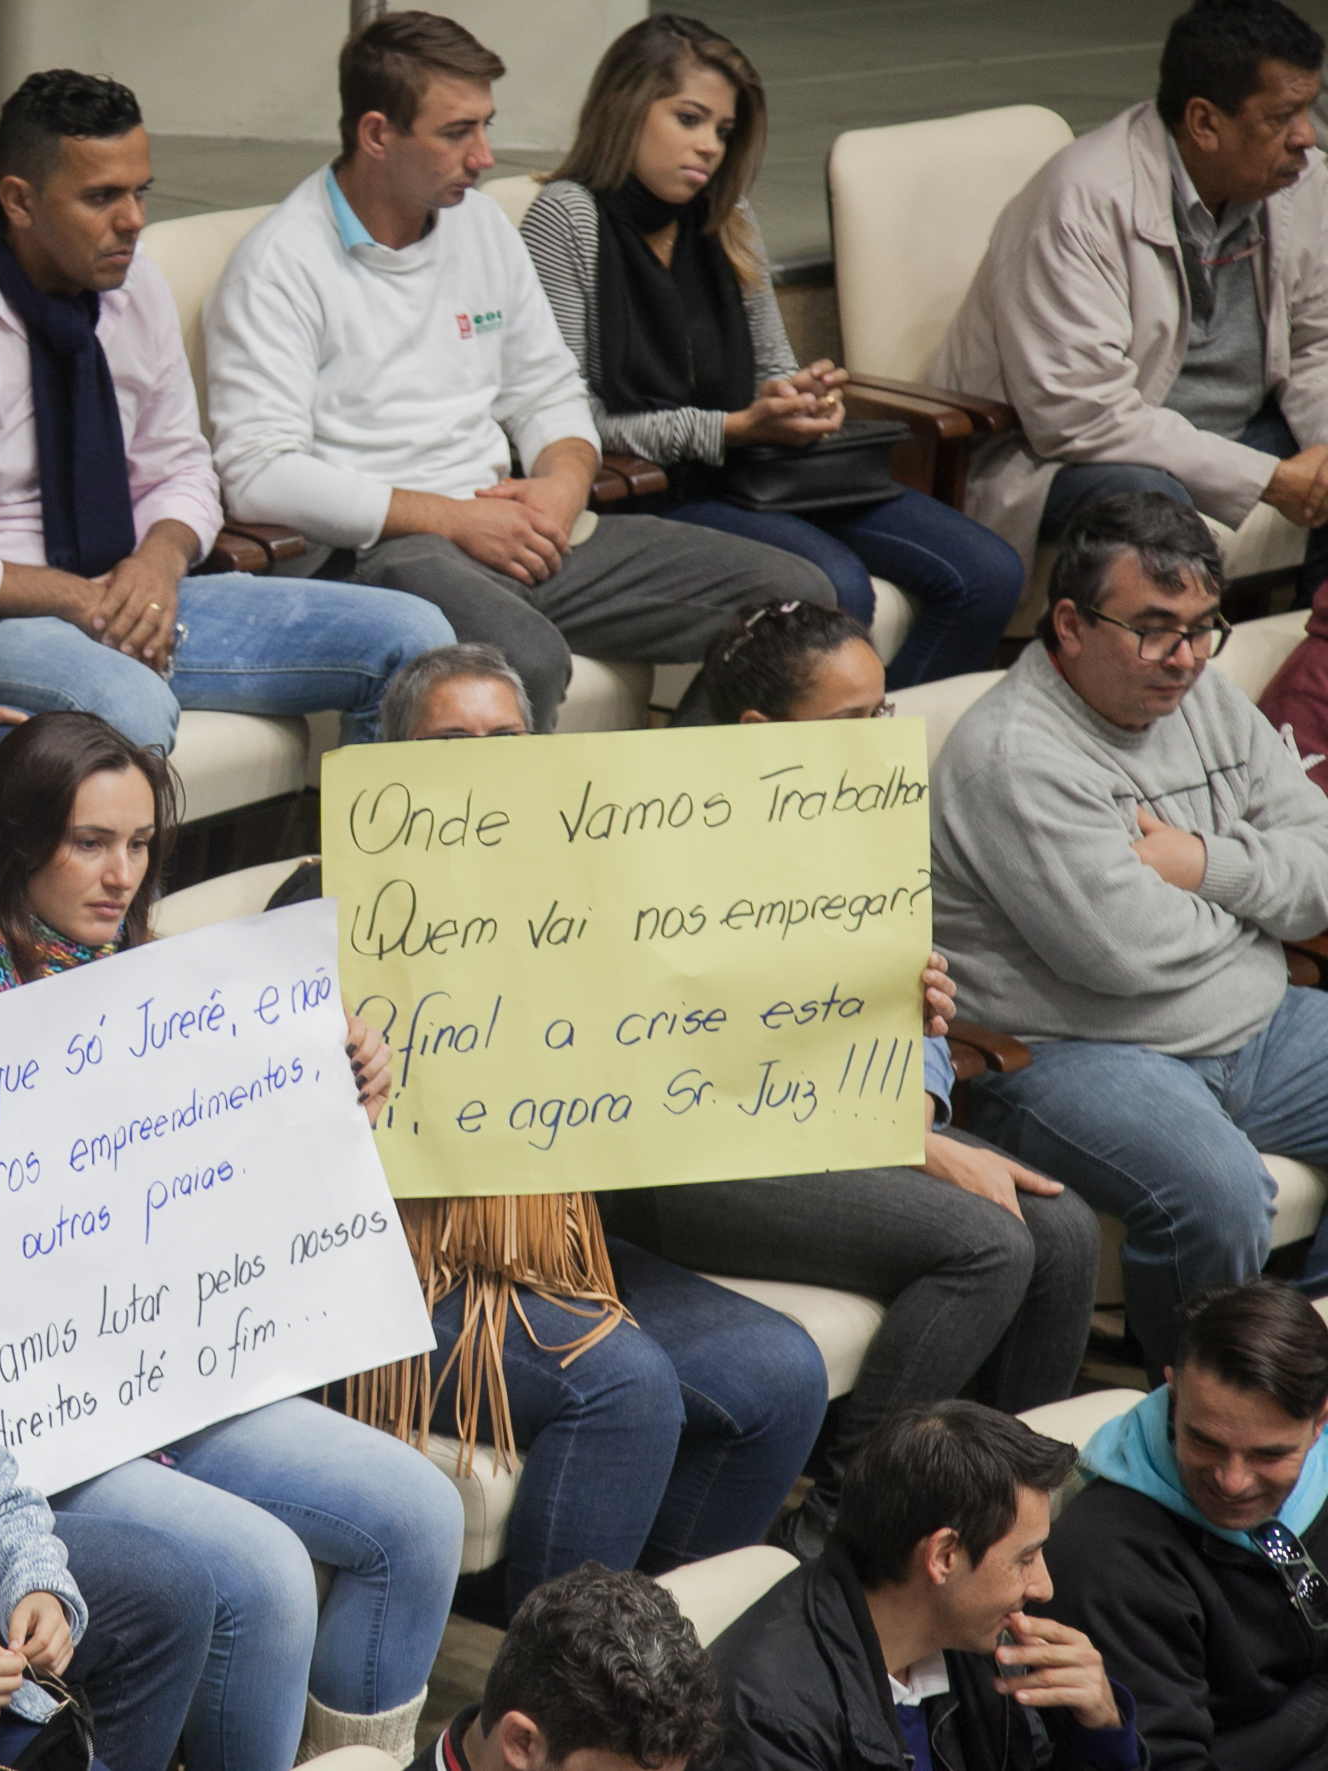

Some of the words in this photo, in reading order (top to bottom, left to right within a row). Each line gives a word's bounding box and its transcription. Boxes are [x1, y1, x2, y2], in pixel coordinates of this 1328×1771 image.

[350, 783, 510, 854] Onde
[351, 879, 497, 961] Quem
[634, 905, 706, 941] nos
[720, 869, 932, 940] empregar?
[66, 1014, 106, 1075] só
[254, 986, 279, 1024] e
[292, 967, 330, 1013] não
[545, 1019, 574, 1049] a
[616, 1001, 727, 1045] crise
[759, 983, 865, 1029] esta
[456, 1100, 487, 1133] e
[509, 1093, 632, 1150] agora
[663, 1069, 717, 1115] Sr.
[23, 1205, 110, 1259] outras
[198, 1253, 265, 1327] pelos
[290, 1211, 387, 1265] nossos
[119, 1350, 166, 1406] até
